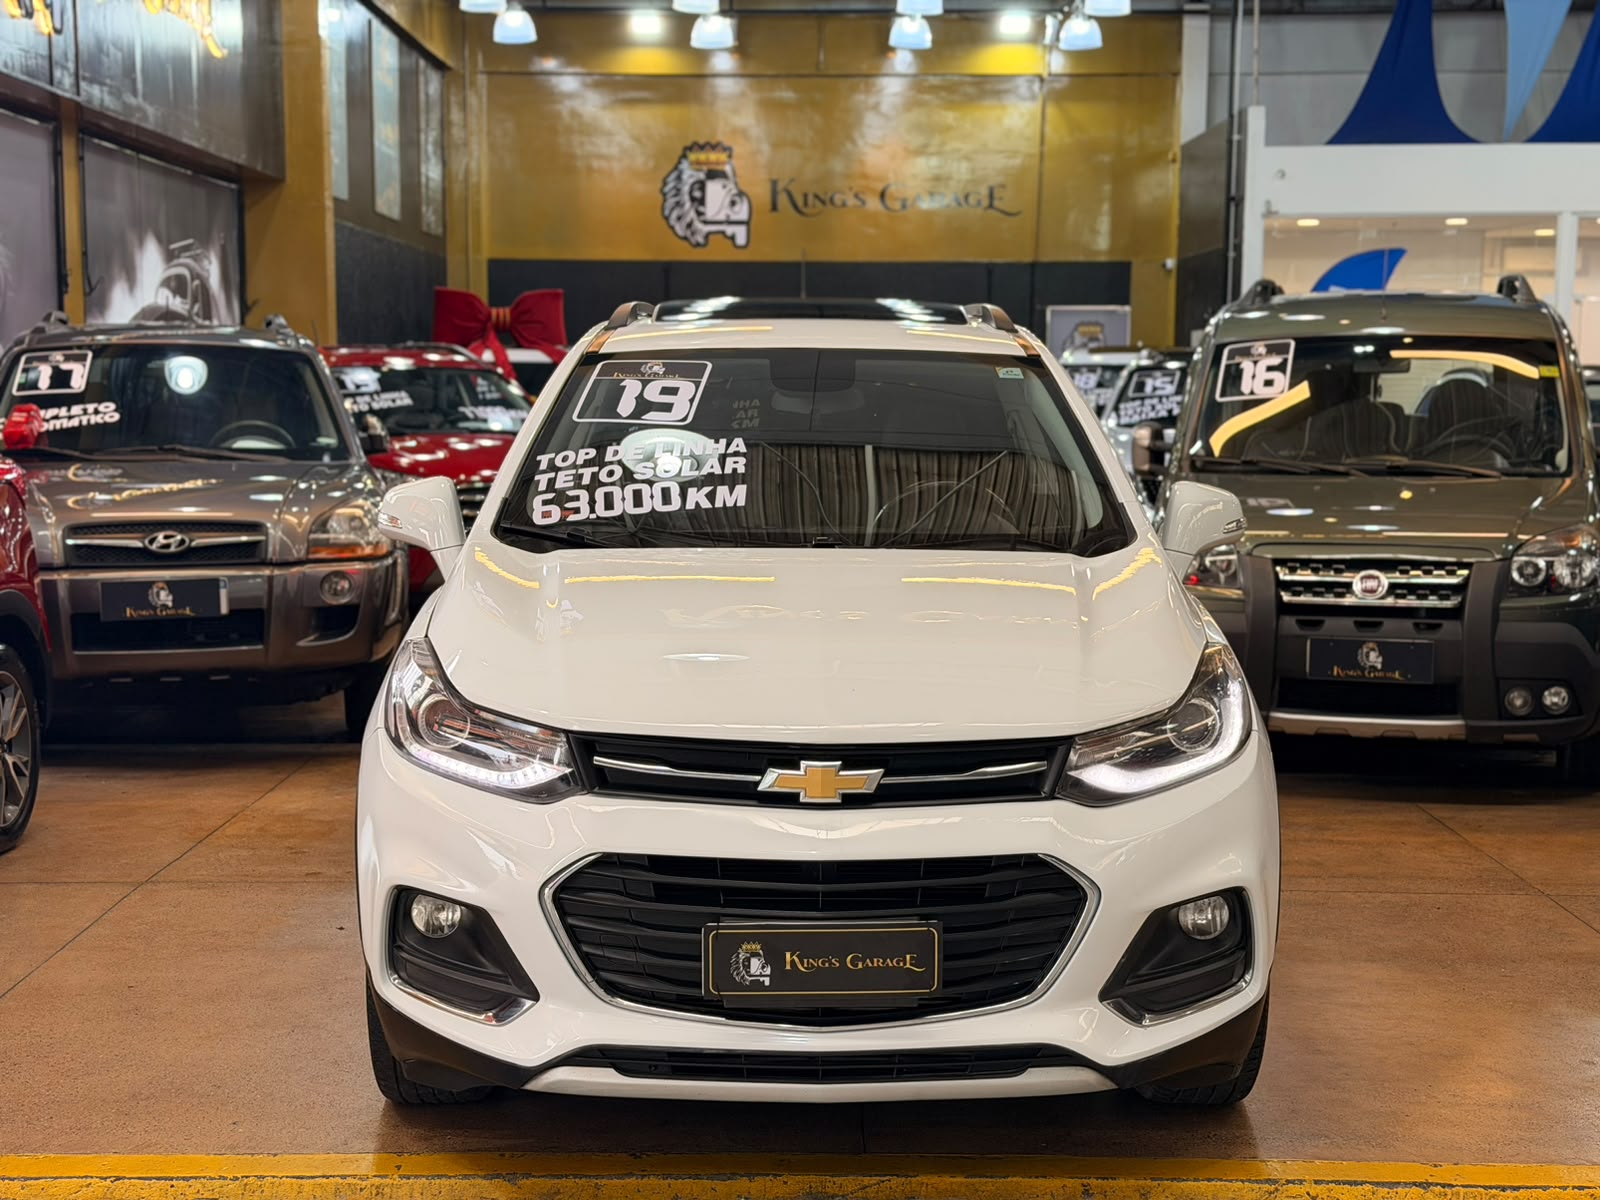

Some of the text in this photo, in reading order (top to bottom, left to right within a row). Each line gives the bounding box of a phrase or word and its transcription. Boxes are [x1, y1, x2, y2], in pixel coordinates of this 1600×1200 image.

[768, 178, 1022, 217] KING'S GARAGE
[1143, 376, 1174, 395] 15
[1240, 357, 1286, 395] 16
[616, 379, 696, 421] 19
[536, 437, 748, 470] TOP DE LINHA
[534, 456, 746, 492] TETO SOLAR
[532, 480, 748, 525] 63.000 KM
[784, 950, 926, 973] KING'S GARAGE
